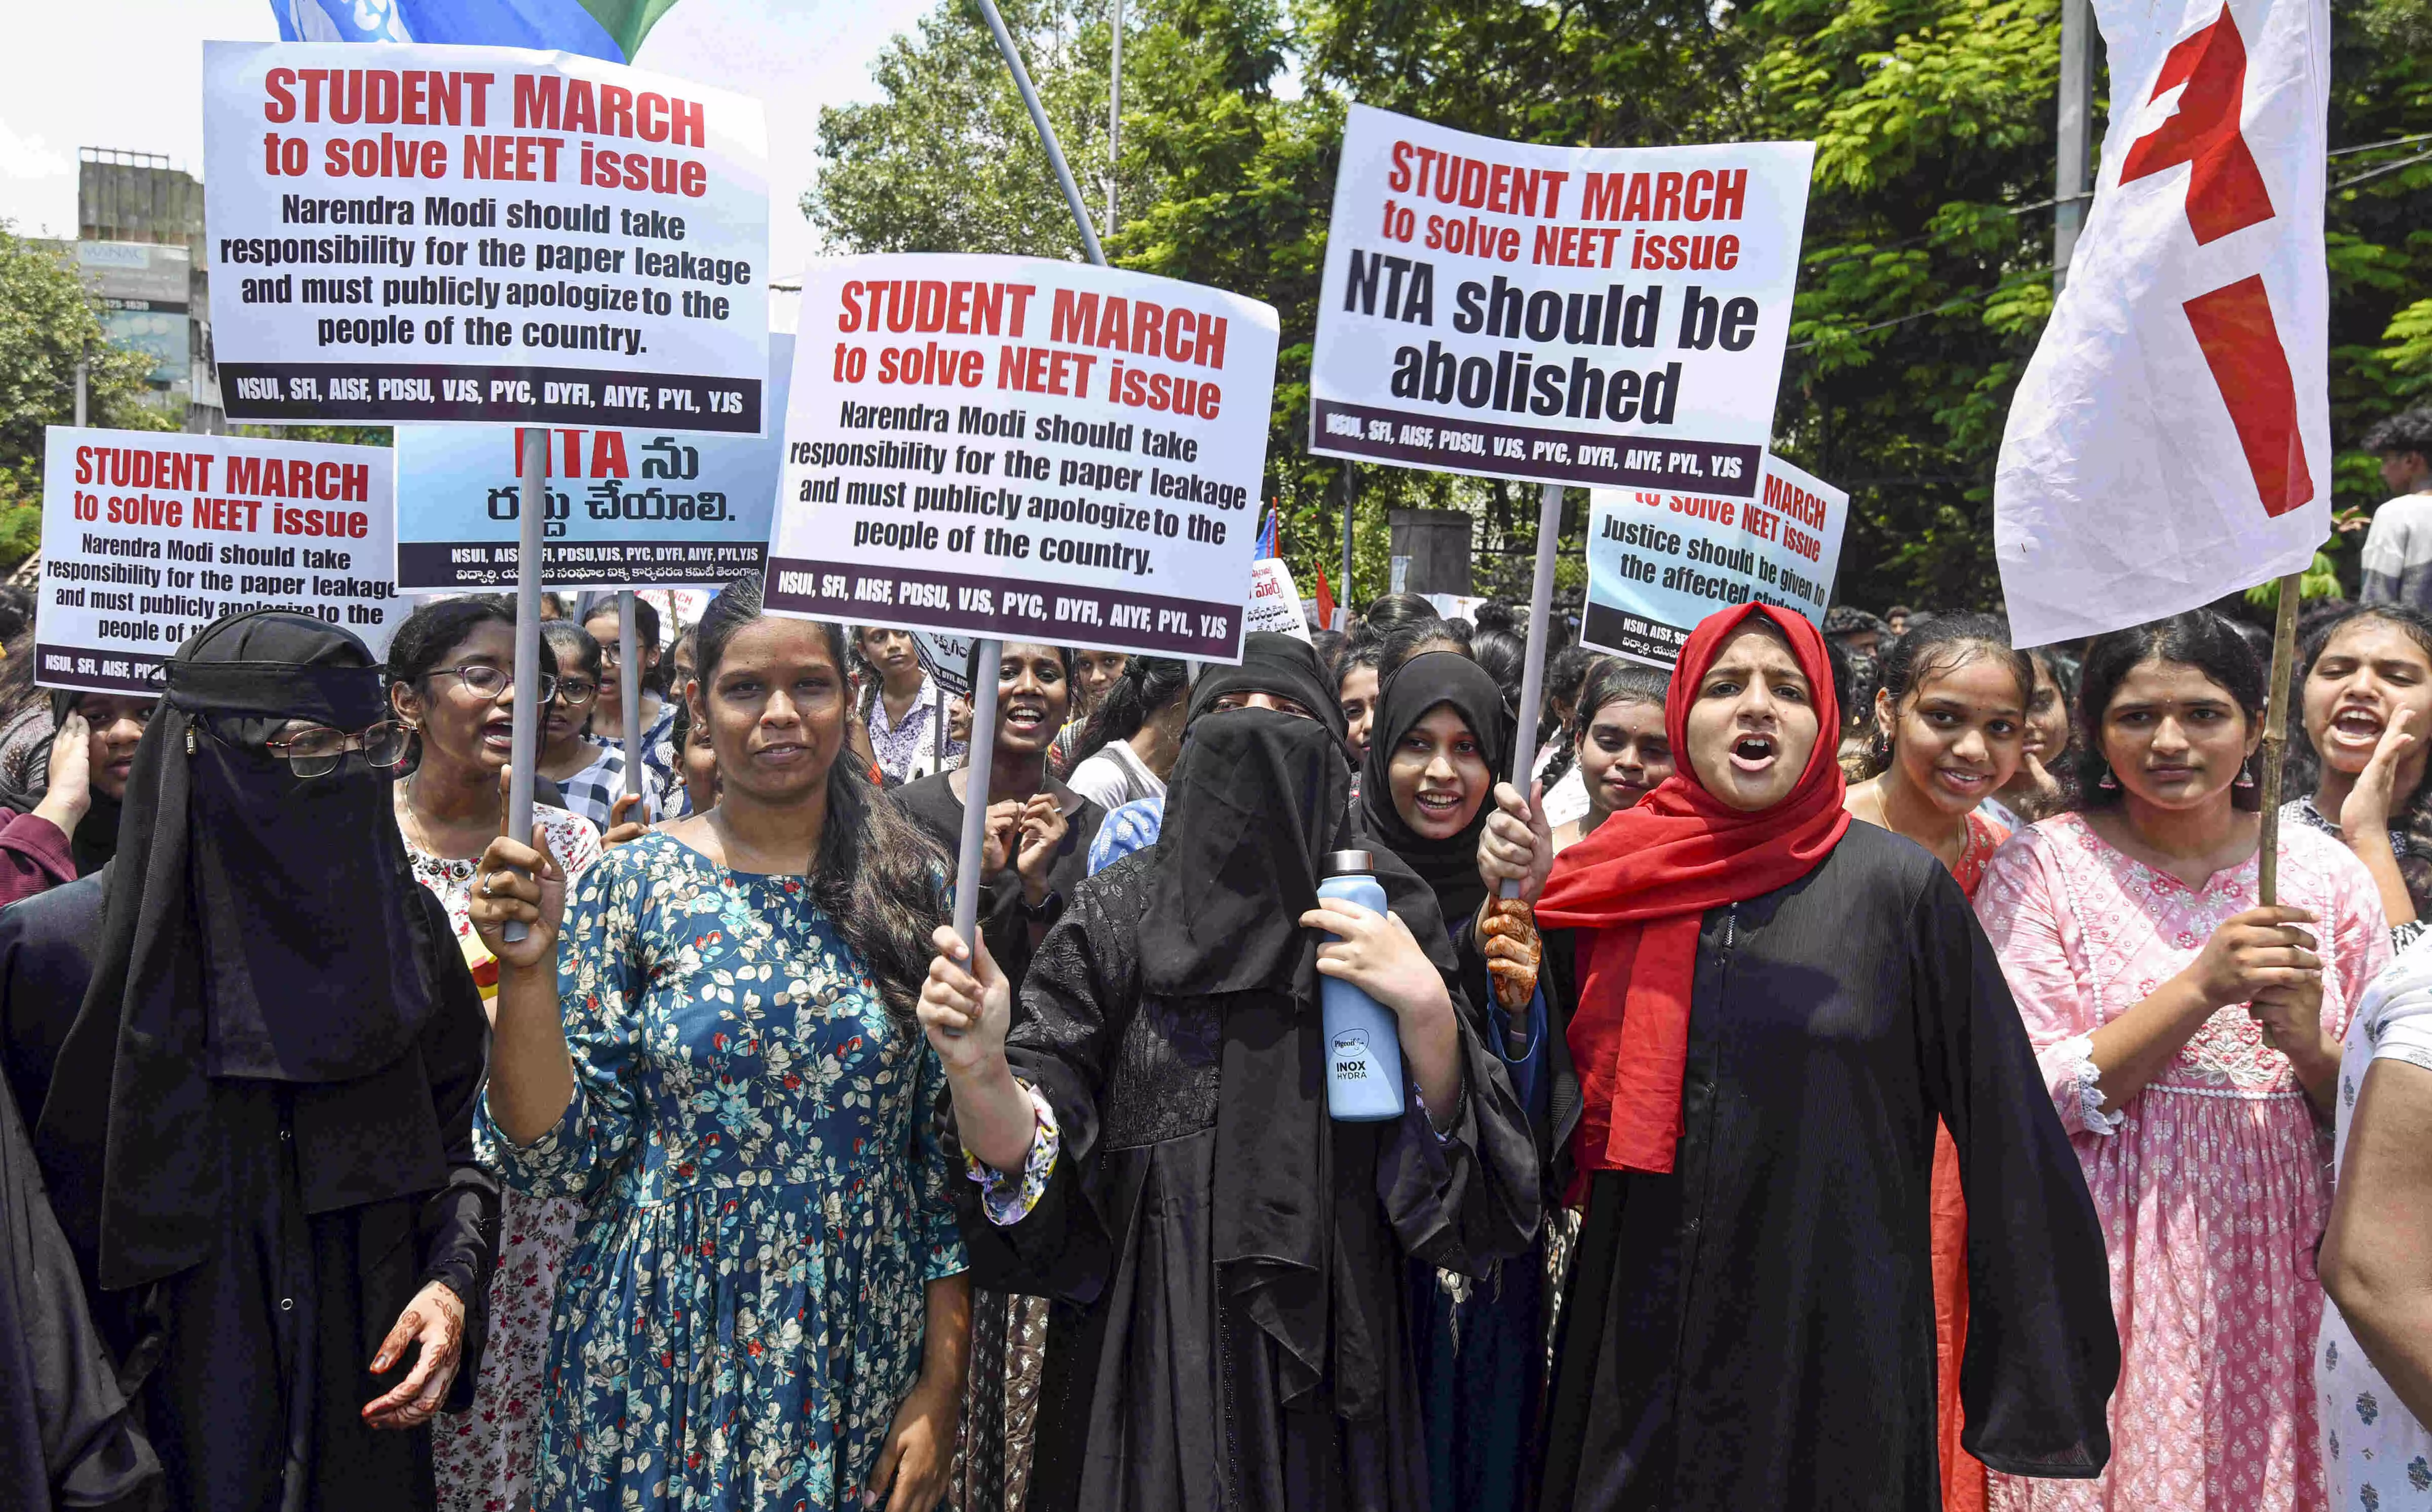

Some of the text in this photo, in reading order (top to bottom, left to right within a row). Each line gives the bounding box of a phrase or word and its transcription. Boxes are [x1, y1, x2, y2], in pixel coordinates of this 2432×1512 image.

[265, 68, 705, 148] STUDENT MARCH
[264, 133, 706, 197] to solve NEET issue
[1390, 141, 1747, 221] STUDENT MARCH
[283, 194, 685, 241] Narendra Modi should take
[1384, 200, 1739, 270] to solve NEET issue
[220, 235, 750, 286] responsibility for the paper leakage
[242, 274, 729, 320] and must publicly apologize to the
[1344, 249, 1758, 352] NTA should be
[318, 315, 647, 356] people of the country.
[839, 281, 1227, 369] STUDENT MARCH
[237, 377, 743, 414] NSUI, SFI, AISF, PDSU, VJS, PYC, DYFI, AIYF, PYL, YJS
[834, 342, 1221, 419] to solve NEET issue
[1391, 340, 1683, 424] abolished
[641, 436, 700, 480] ను
[840, 401, 1198, 462] Narendra Modi should take
[1368, 419, 1395, 445] SFI,
[1398, 424, 1434, 450] AISF,
[1438, 430, 1486, 456] PDSU,
[1493, 436, 1526, 461] VJS,
[1532, 441, 1572, 466] PYC,
[1577, 445, 1619, 470] DYFI,
[1624, 449, 1662, 474] AIYF,
[1667, 452, 1703, 478] PYL,
[1711, 455, 1742, 479] YJS
[75, 446, 367, 501] STUDENT MARCH
[790, 440, 1247, 510] responsibility for the paper leakage
[74, 491, 367, 537] to solve NEET issue
[800, 477, 1226, 545] and must publicly apologize to the
[1764, 474, 1827, 531] MARCH
[82, 533, 351, 570] Narendra Modi should take
[451, 548, 489, 564] NSUI,
[626, 547, 654, 562] PYC,
[656, 547, 686, 562] DYFI,
[688, 548, 716, 562] AIYF,
[854, 521, 1153, 575] people of the country.
[1741, 503, 1780, 541] NEET
[1782, 521, 1820, 562] issue
[47, 560, 161, 589] responsibility
[167, 567, 195, 589] for
[201, 570, 234, 592] the
[241, 575, 306, 596] paper
[1601, 514, 1681, 556] Justice
[1686, 537, 1754, 576] should
[1758, 556, 1777, 585] be
[1779, 567, 1812, 602] given
[1813, 583, 1826, 607] to
[1620, 553, 1656, 584] the
[1661, 566, 1751, 605] affected
[56, 587, 85, 607] and
[90, 591, 134, 611] must
[140, 594, 215, 619] publicly
[317, 602, 340, 624] to
[347, 604, 384, 625] the
[98, 619, 159, 641] people
[165, 623, 184, 643] of
[778, 570, 816, 598] NSUI,
[821, 574, 849, 601] SFI,
[854, 577, 893, 606] AISF,
[898, 581, 951, 611] PDSU,
[959, 587, 995, 616] VJS,
[1002, 591, 1047, 622] PYC,
[1055, 597, 1103, 627] DYFI,
[1110, 603, 1151, 633] AIYF,
[1158, 609, 1193, 638] PYL,
[1200, 614, 1227, 639] YJS
[1622, 617, 1649, 637] NSUI,
[46, 654, 130, 679] NSUI, SFI, AISF,
[1334, 1039, 1355, 1049] Pigeon
[1336, 1061, 1366, 1072] INOX
[1337, 1072, 1367, 1080] HYDRA
